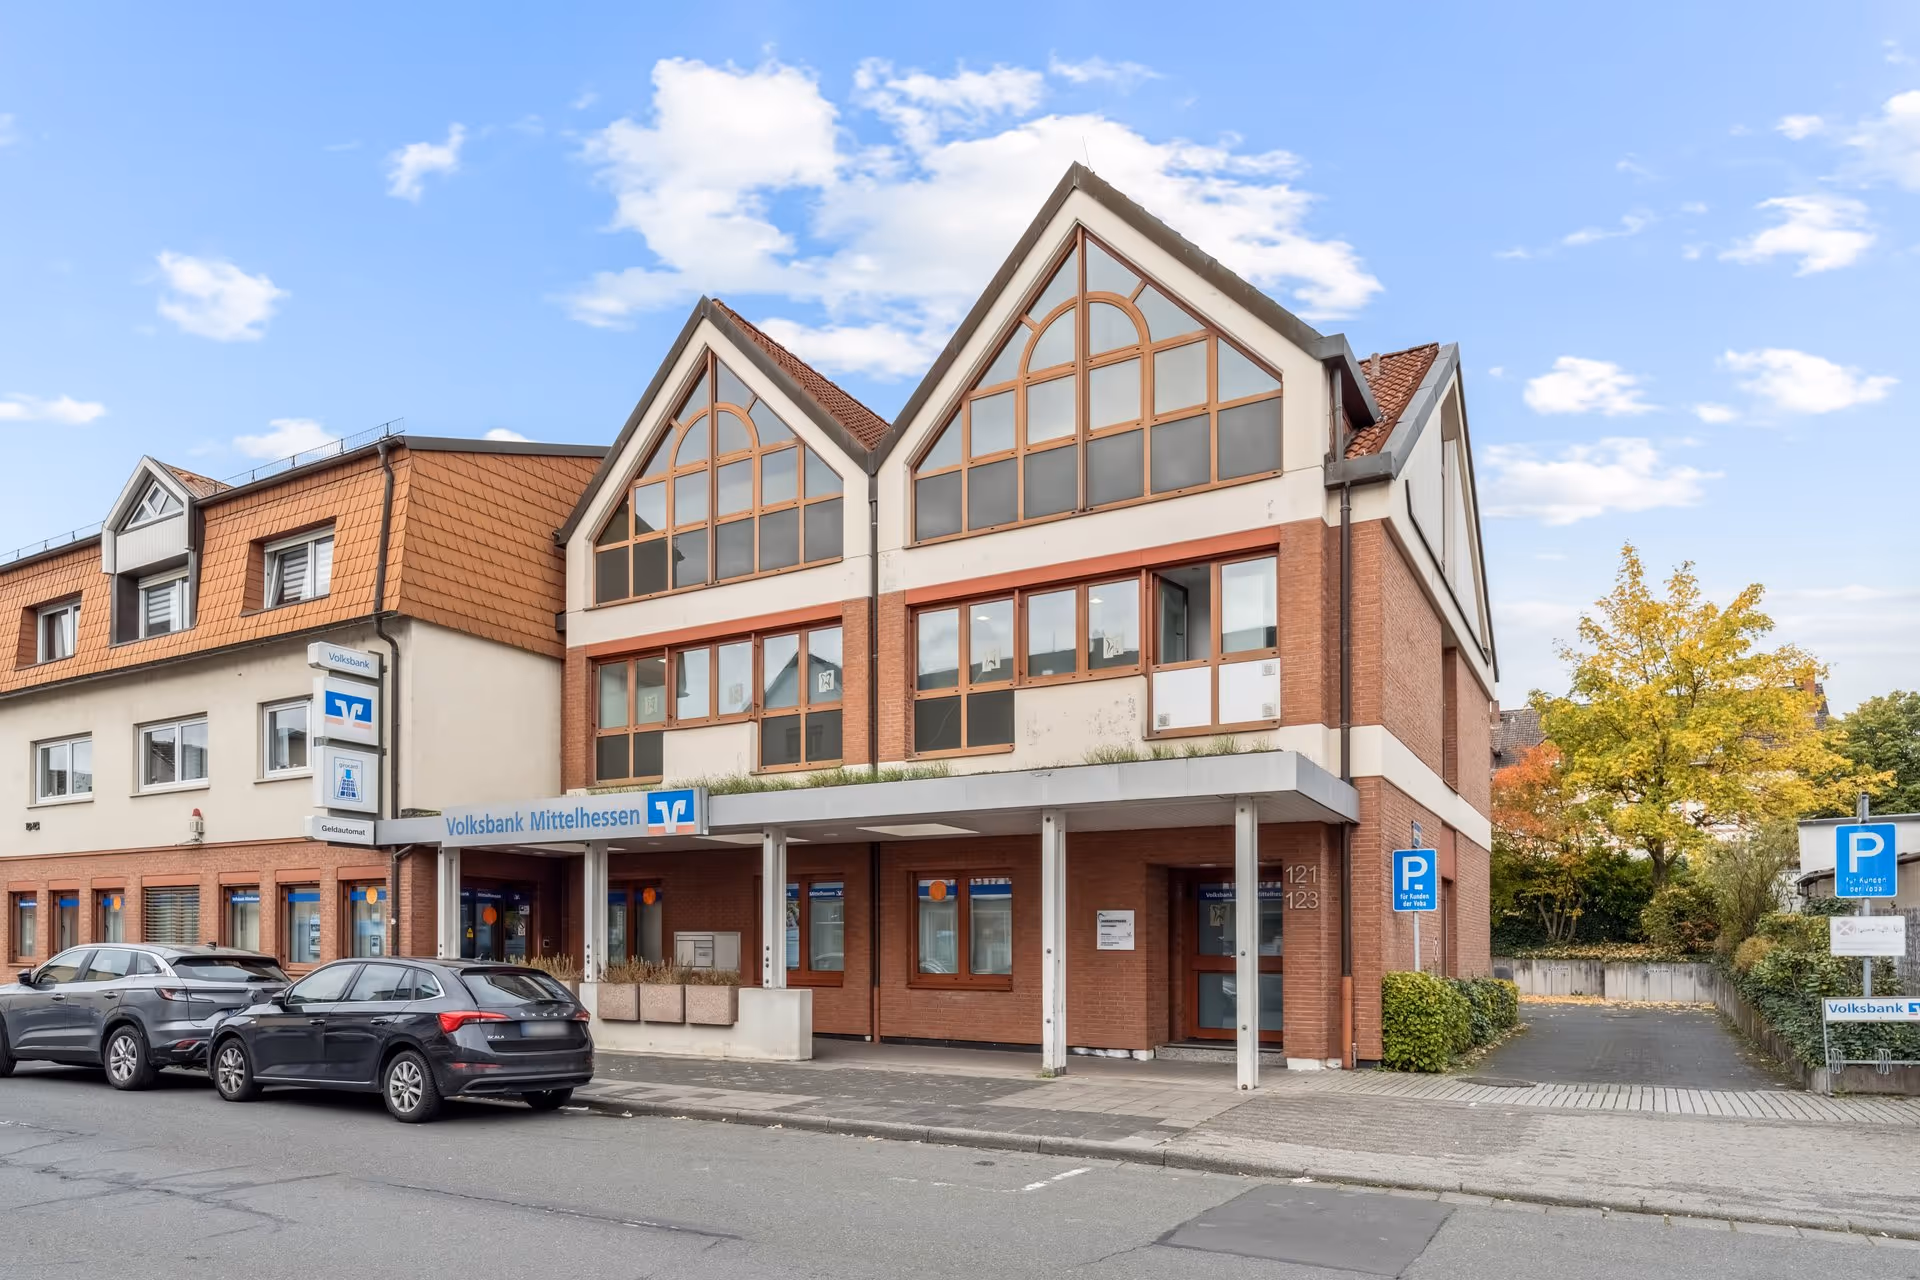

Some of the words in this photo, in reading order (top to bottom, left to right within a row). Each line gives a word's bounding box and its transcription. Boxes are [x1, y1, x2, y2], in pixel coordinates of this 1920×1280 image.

[328, 651, 370, 669] Volksbank
[321, 824, 366, 836] Geldautomat
[445, 811, 524, 836] Volksbank
[530, 806, 640, 832] Mittelhessen
[1849, 832, 1884, 873] P
[1285, 865, 1318, 884] 121
[1402, 856, 1428, 891] P
[1285, 890, 1319, 910] 123
[1828, 1002, 1904, 1014] Volksbank
